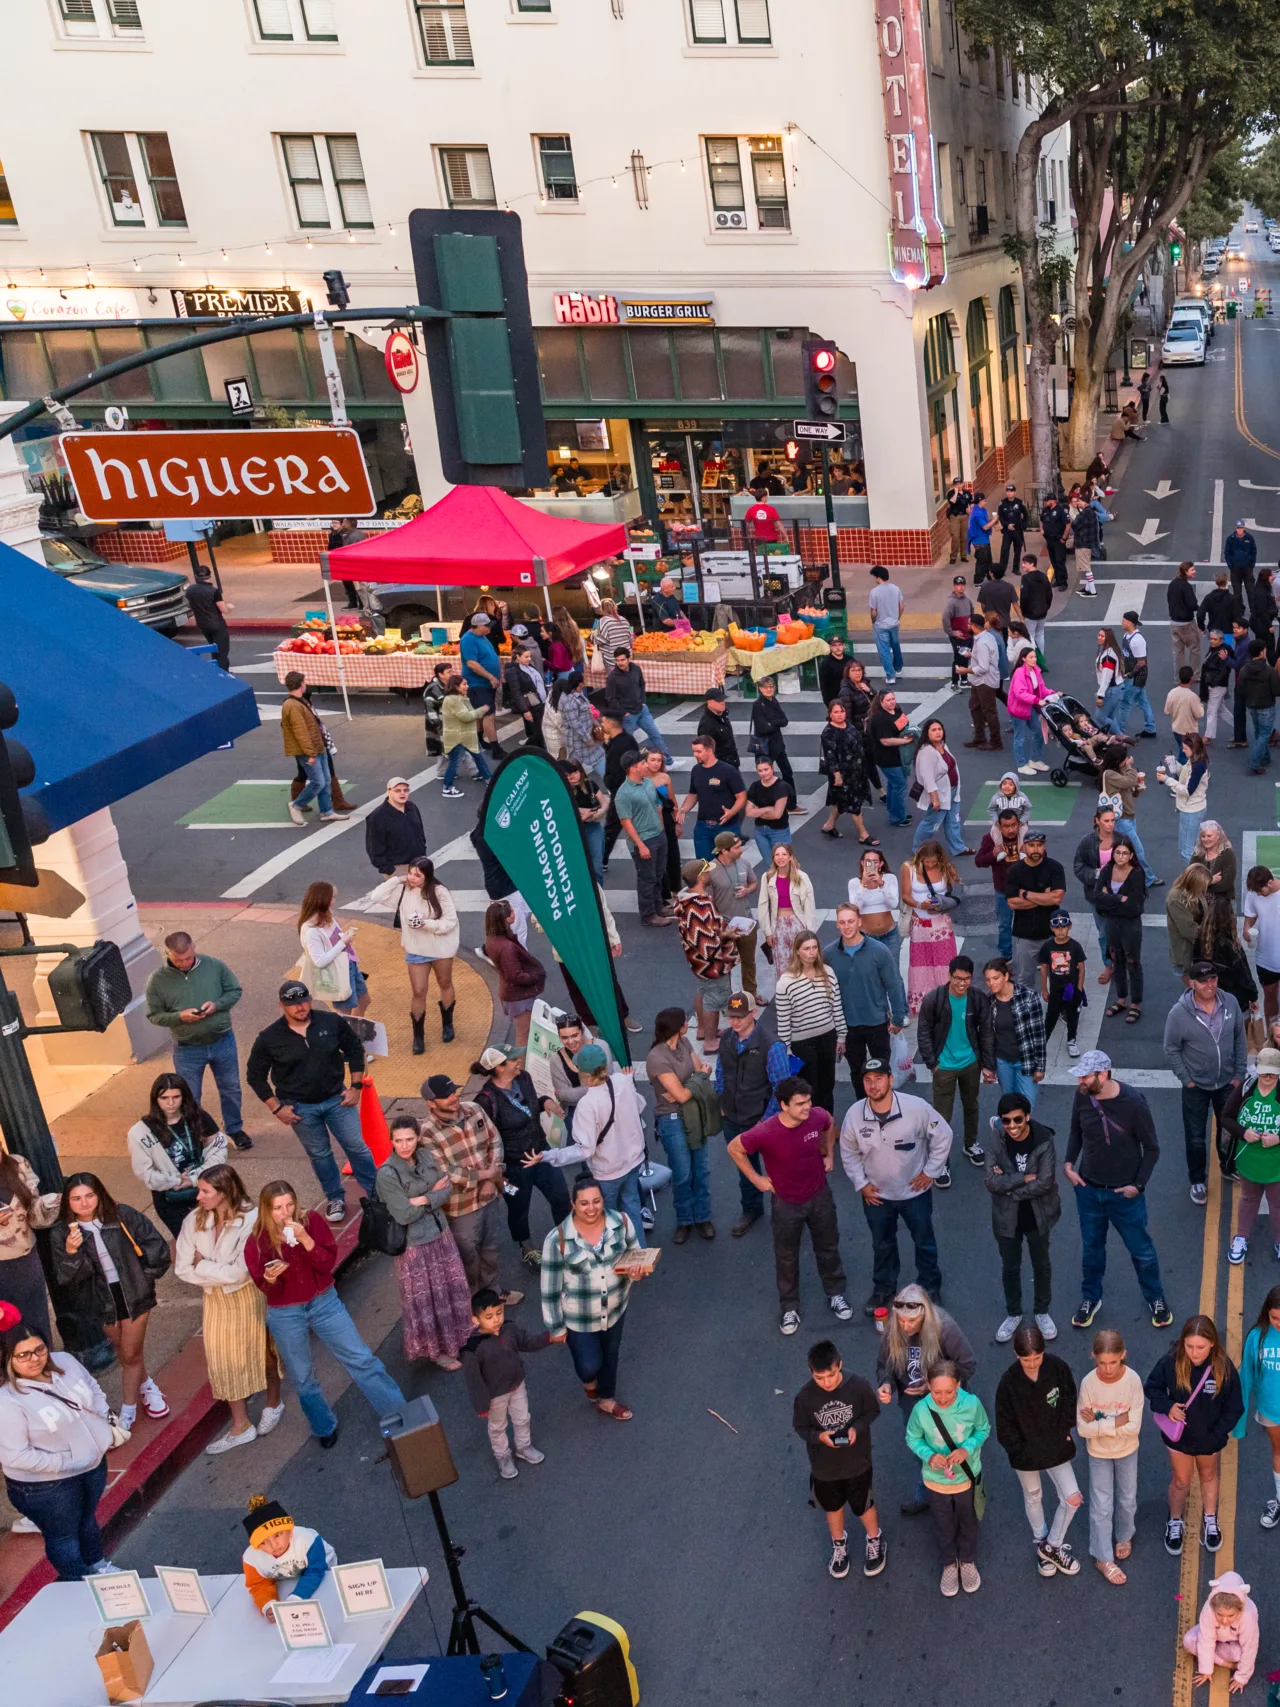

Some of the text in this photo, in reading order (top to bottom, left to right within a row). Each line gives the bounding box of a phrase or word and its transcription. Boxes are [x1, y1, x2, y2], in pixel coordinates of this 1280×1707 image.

[192, 292, 294, 313] PREMIER
[553, 292, 709, 324] Habit BURGER GRILL
[677, 420, 697, 429] 839
[799, 426, 812, 434] ONE
[505, 769, 528, 806] CAL POLY
[540, 798, 577, 917] TECHNOLOGY
[530, 819, 562, 921] PACKAGING
[813, 1404, 854, 1425] VANS
[100, 1583, 131, 1592] SCHEDULE
[347, 1582, 366, 1590] SIGN
